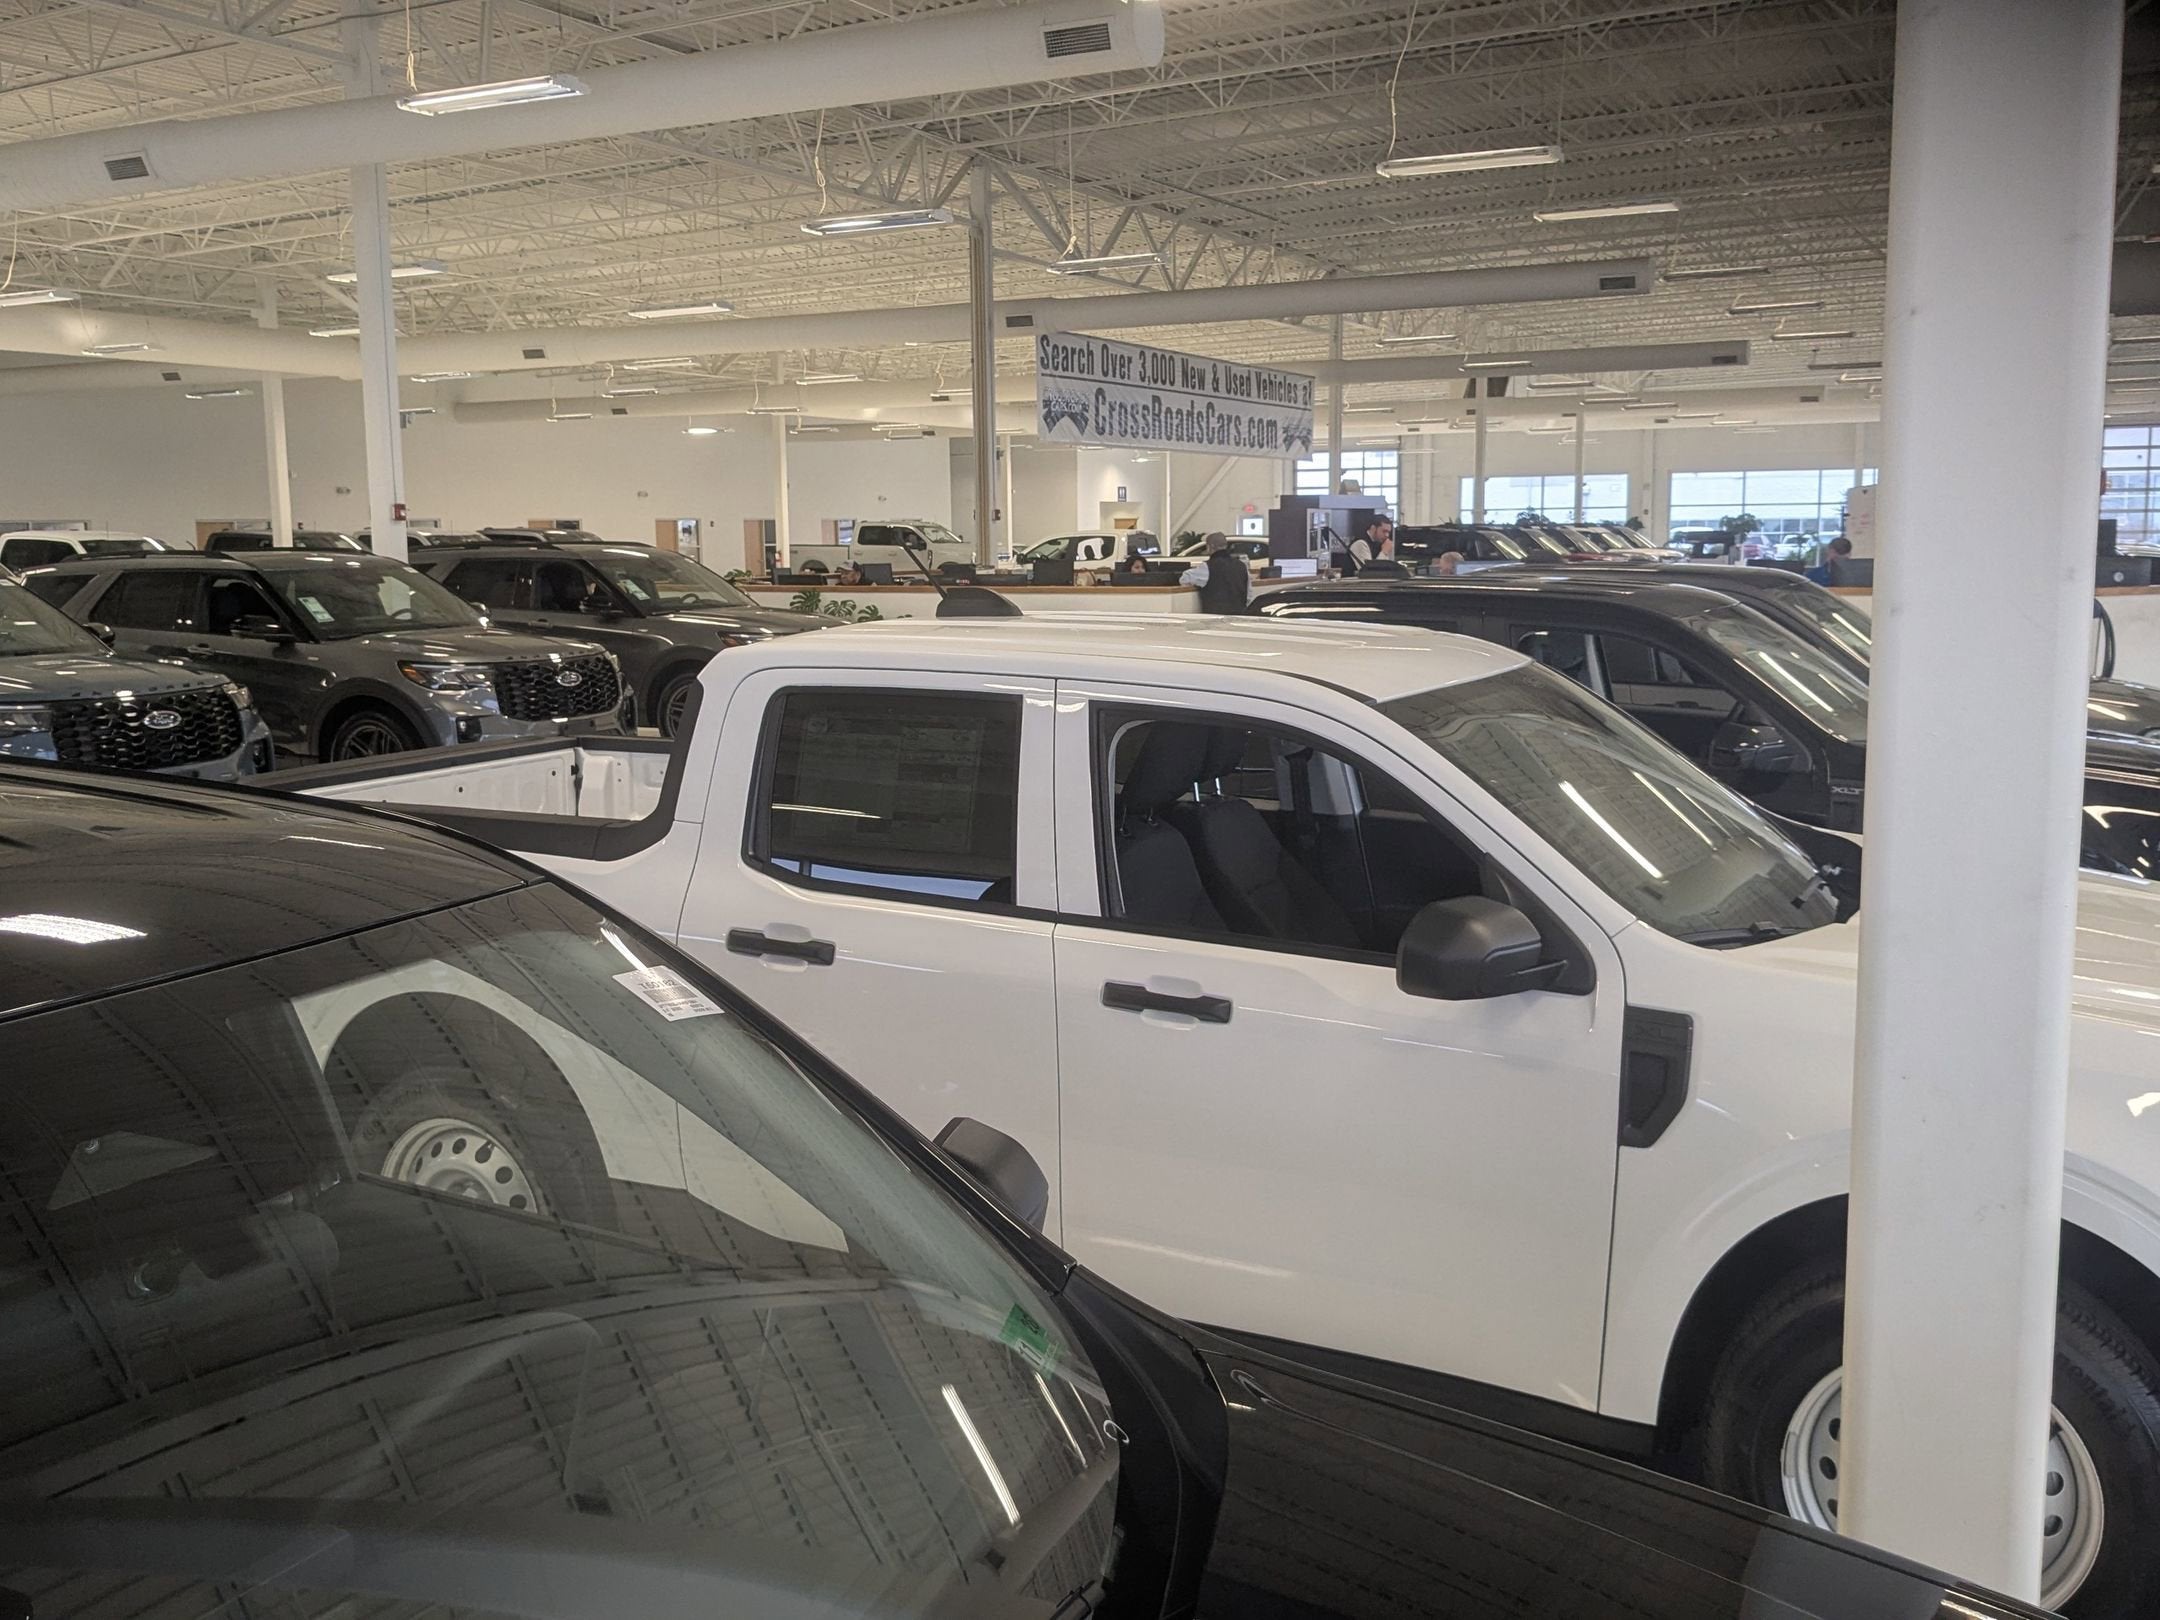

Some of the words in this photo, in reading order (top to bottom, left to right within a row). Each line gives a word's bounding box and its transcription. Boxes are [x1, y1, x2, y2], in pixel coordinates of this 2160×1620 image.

[1040, 334, 1095, 376] Search
[1101, 343, 1133, 380] Over
[1139, 350, 1176, 387] 3,000
[1181, 357, 1206, 391] New
[1211, 362, 1220, 393] &
[1224, 365, 1252, 398] Used
[1254, 370, 1298, 405] Vehicles
[1302, 380, 1312, 407] at
[1094, 387, 1278, 450] CrossRoadsCars.com
